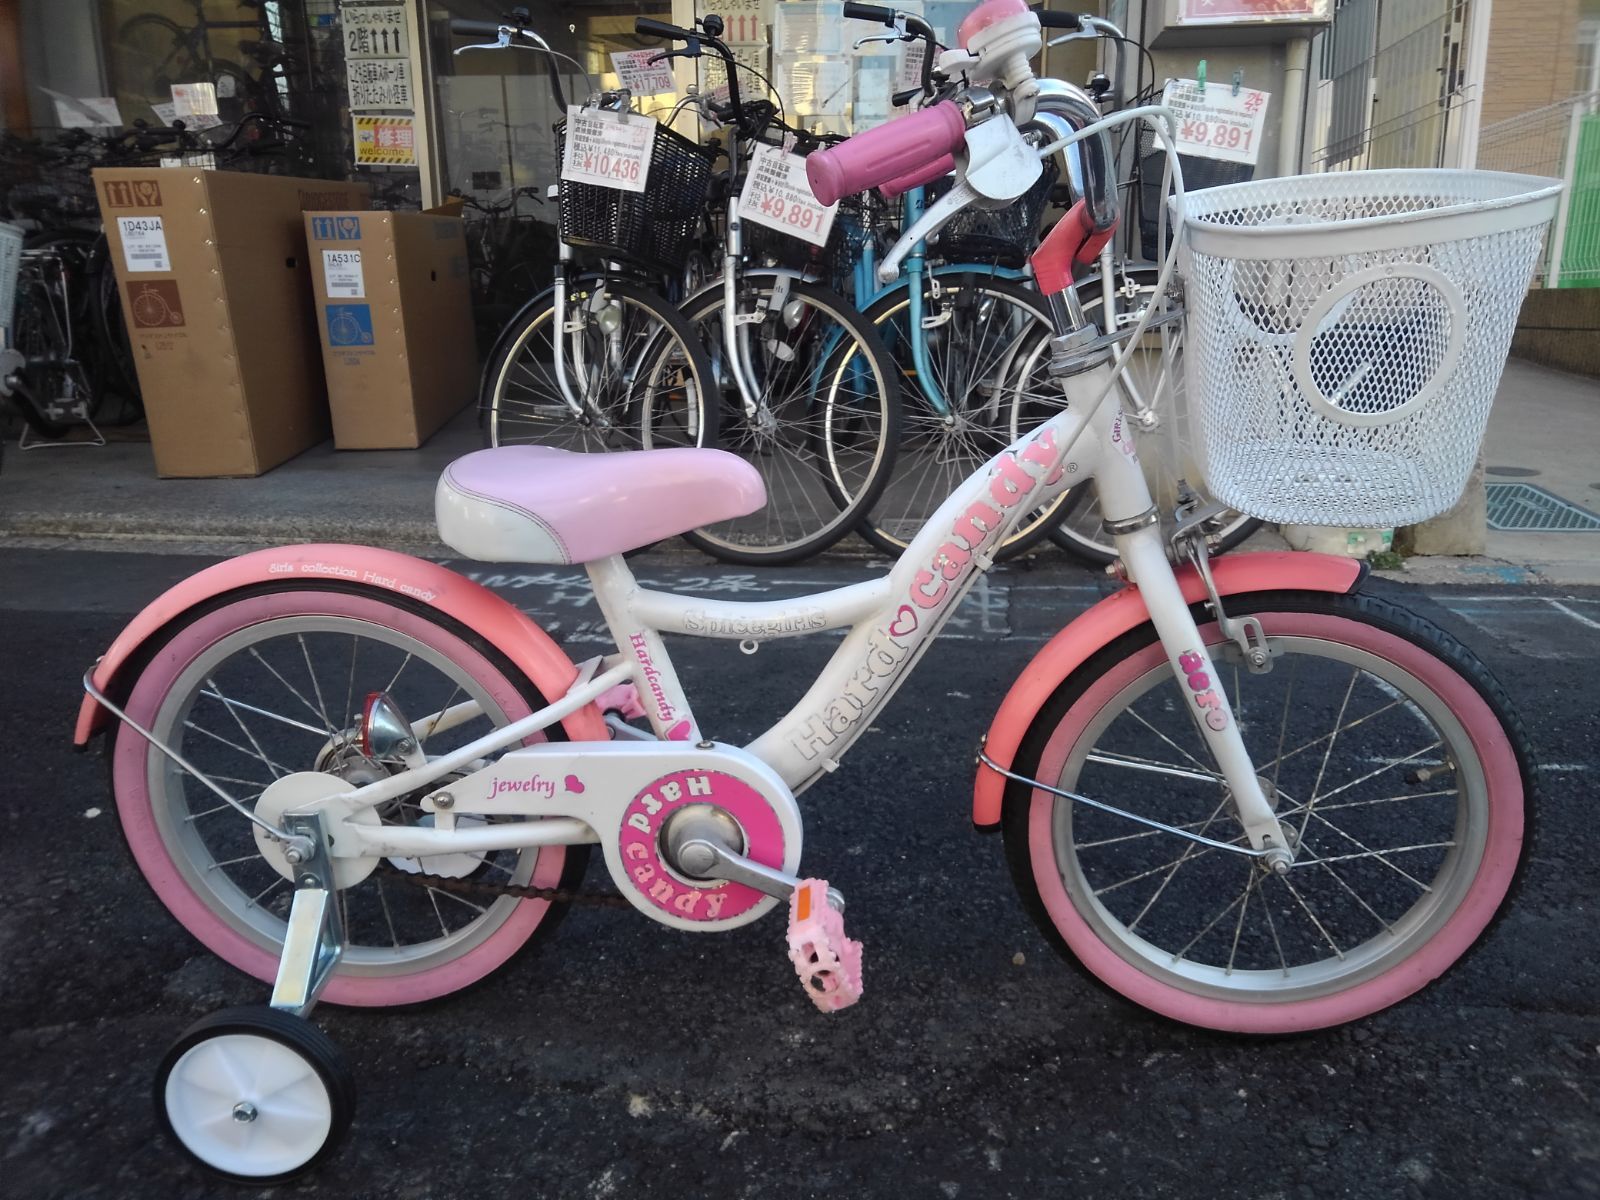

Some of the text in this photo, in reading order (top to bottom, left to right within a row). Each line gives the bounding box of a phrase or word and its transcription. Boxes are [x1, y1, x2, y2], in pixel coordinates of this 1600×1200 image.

[344, 8, 401, 24] いらっしゃいませ
[348, 27, 369, 53] 2階
[379, 127, 413, 147] 修理
[1181, 119, 1253, 151] ¥9,891
[360, 148, 405, 156] welcome
[583, 151, 640, 180] ¥10,436
[123, 220, 162, 232] 1D43JA
[760, 192, 824, 233] ¥9,891
[327, 253, 361, 263] 1A531C
[301, 563, 357, 578] collection
[363, 570, 397, 588] Hard
[400, 584, 437, 602] candy
[785, 628, 909, 761] Hard
[909, 427, 1066, 609] candy
[629, 632, 677, 722] Hardcandy
[486, 774, 556, 800] jewelry
[628, 776, 713, 834] Hard
[626, 841, 728, 917] candy
